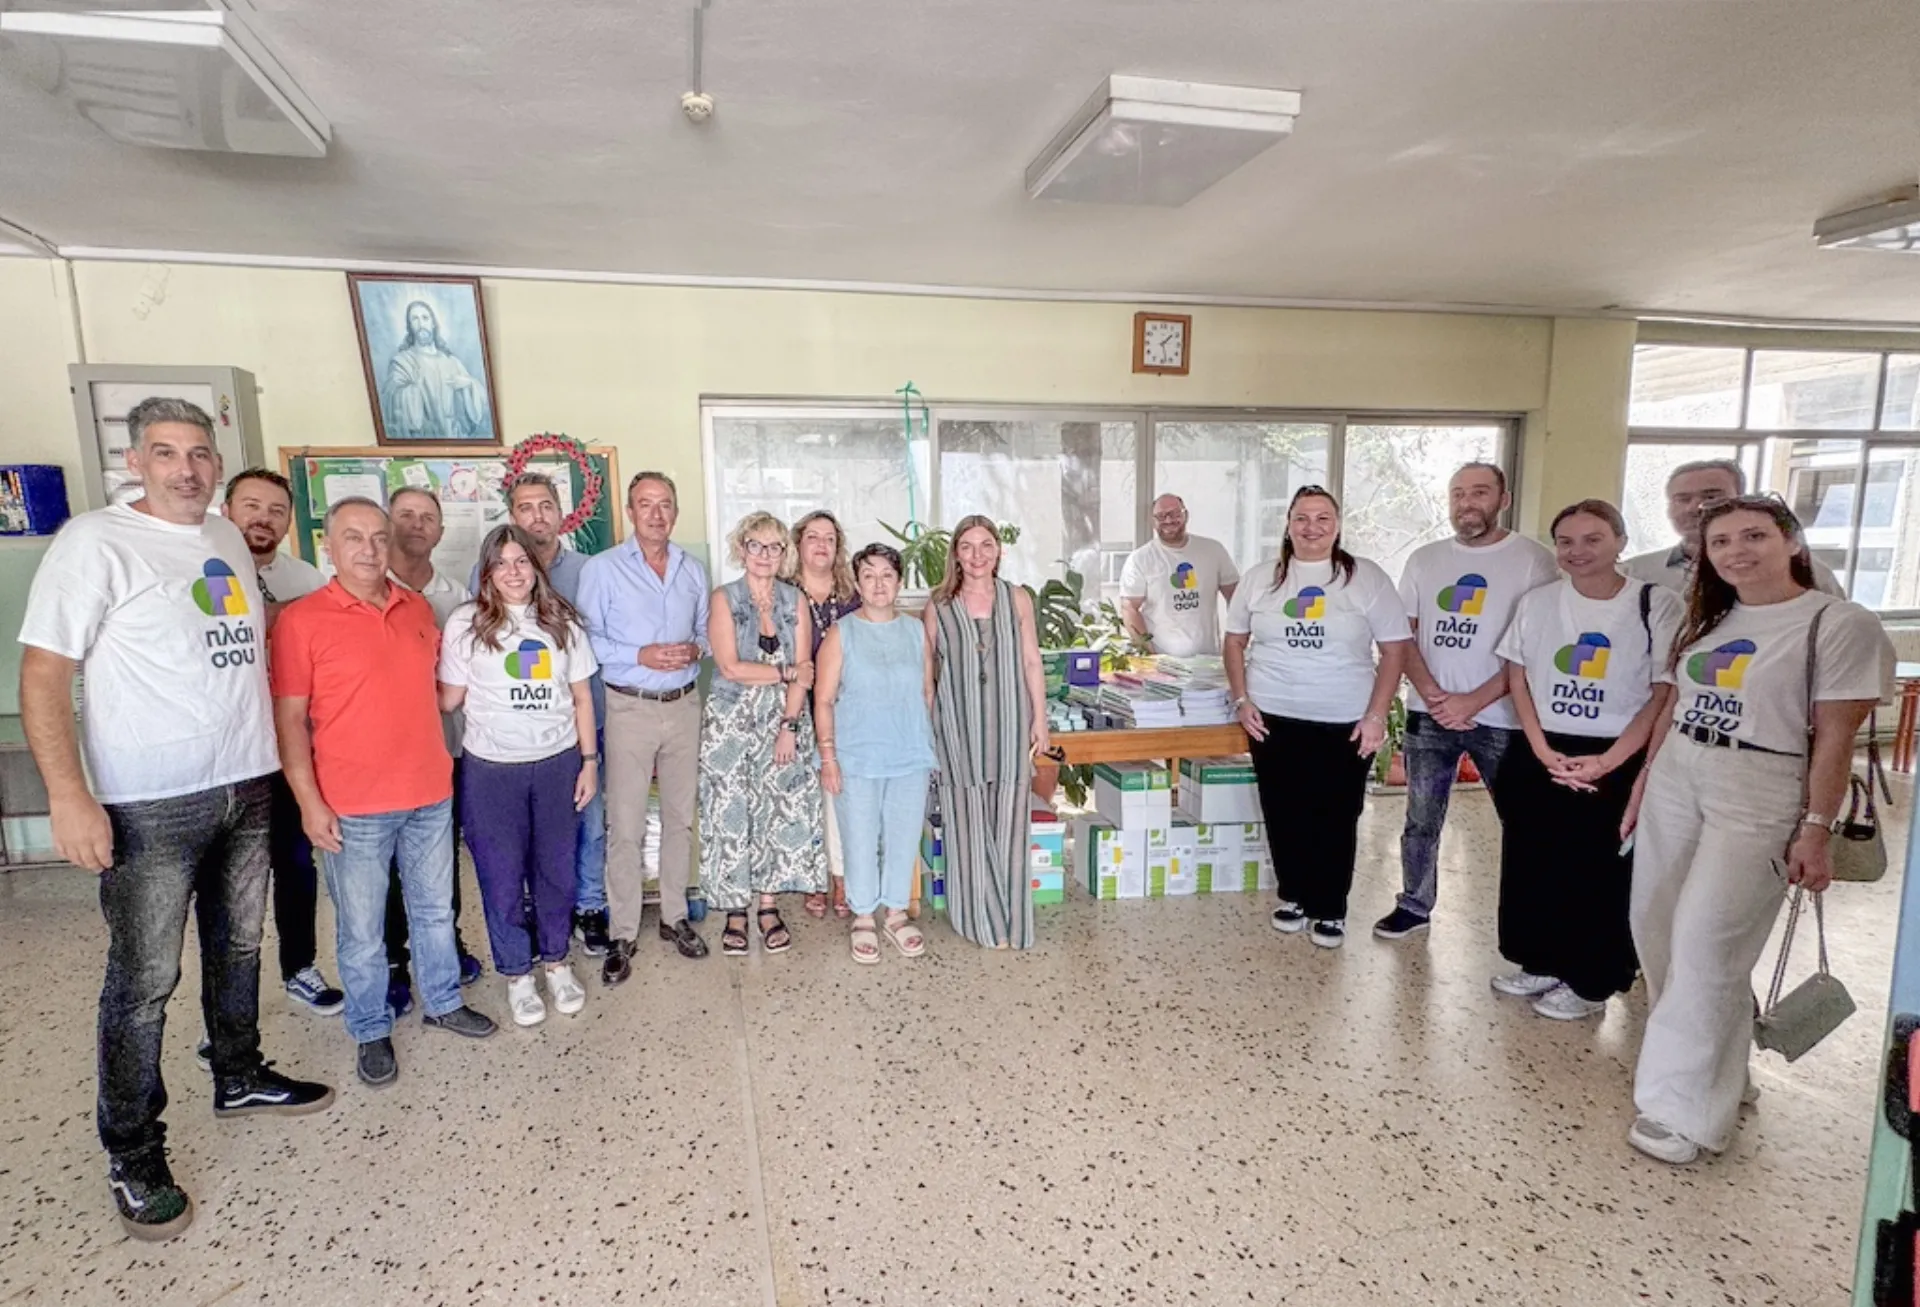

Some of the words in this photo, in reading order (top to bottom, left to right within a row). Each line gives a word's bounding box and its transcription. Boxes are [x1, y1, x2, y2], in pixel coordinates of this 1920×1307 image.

[205, 620, 254, 647] πλάι
[1285, 621, 1325, 637] πλάι
[1436, 616, 1478, 635] πλάι
[1434, 635, 1472, 649] σου
[211, 648, 255, 668] σου
[510, 684, 552, 700] πλάι
[1552, 679, 1604, 702] πλάι
[1551, 701, 1600, 719] σου
[1695, 691, 1743, 717] πλάι
[1684, 709, 1740, 731] σου
